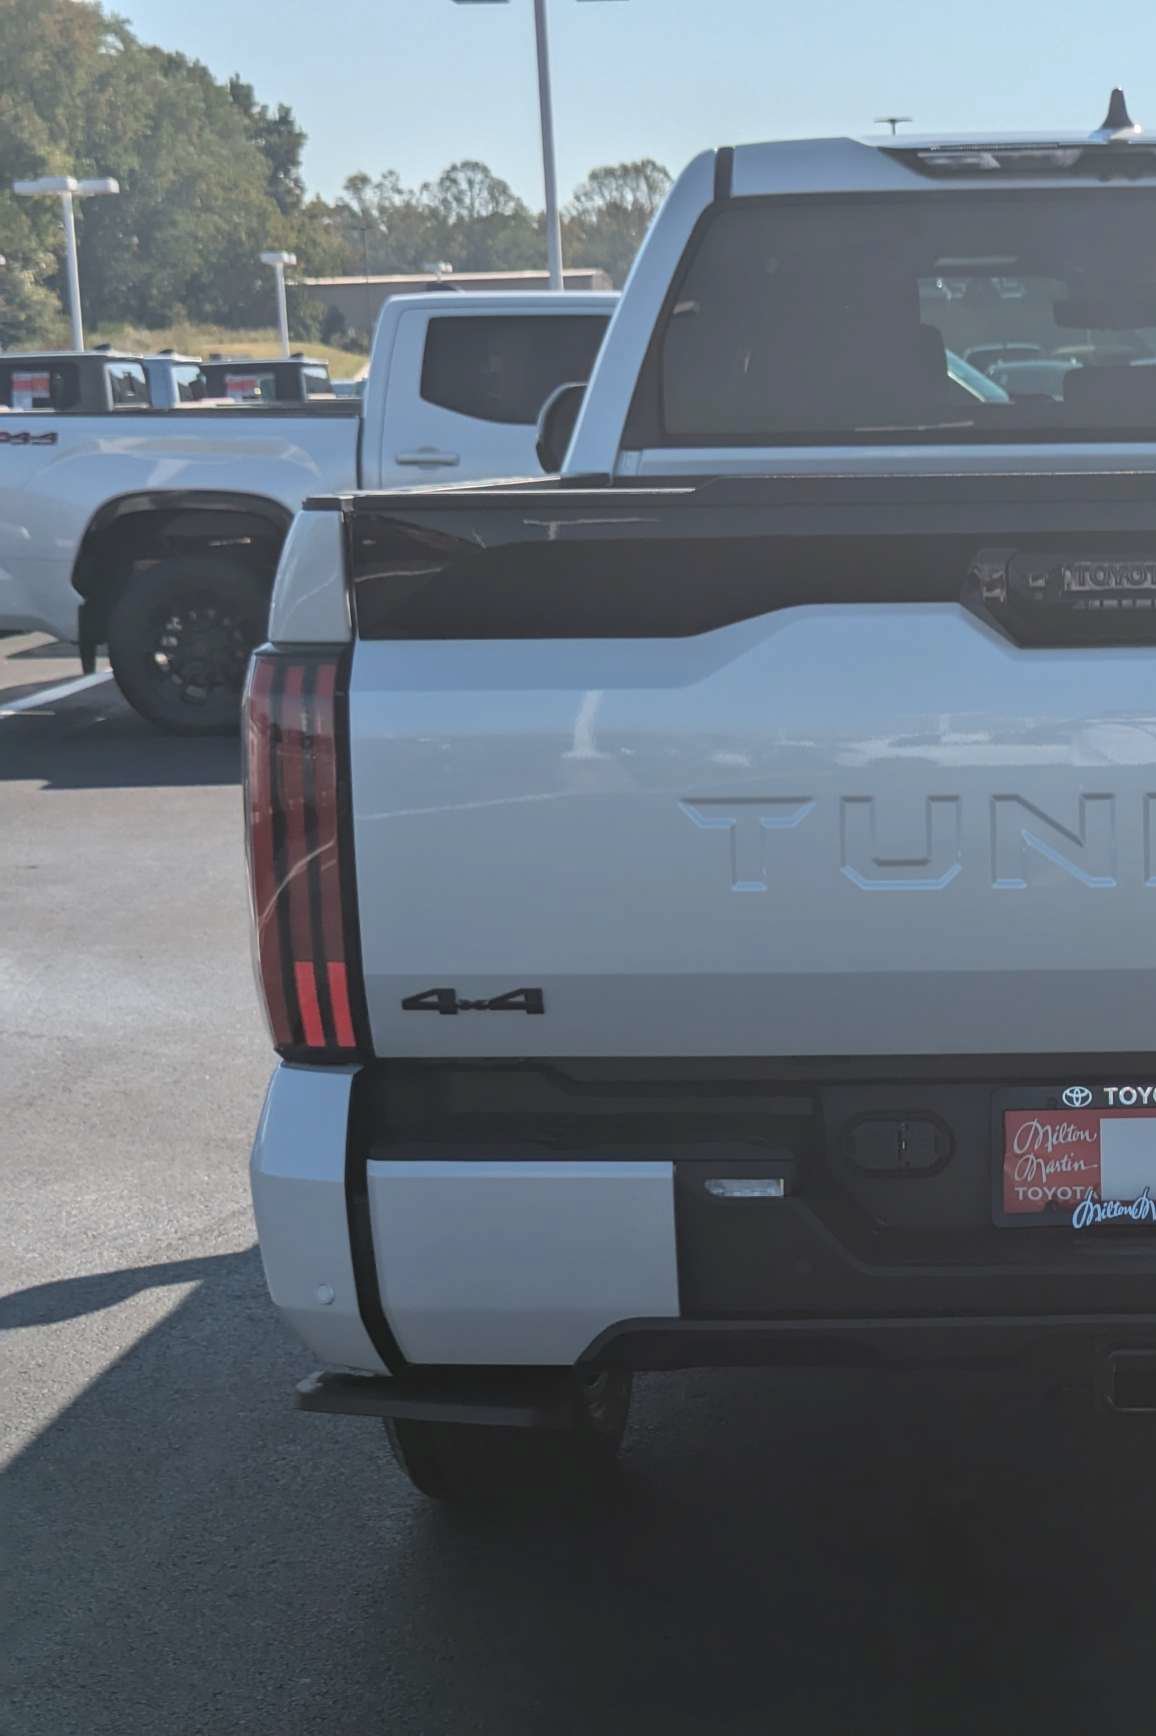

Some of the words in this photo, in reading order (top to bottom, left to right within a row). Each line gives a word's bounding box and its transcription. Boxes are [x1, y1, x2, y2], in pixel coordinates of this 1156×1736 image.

[1013, 1118, 1097, 1154] Milton
[1014, 1152, 1099, 1183] Martin
[1015, 1186, 1099, 1201] TOYOTA
[1072, 1187, 1134, 1229] Milton
